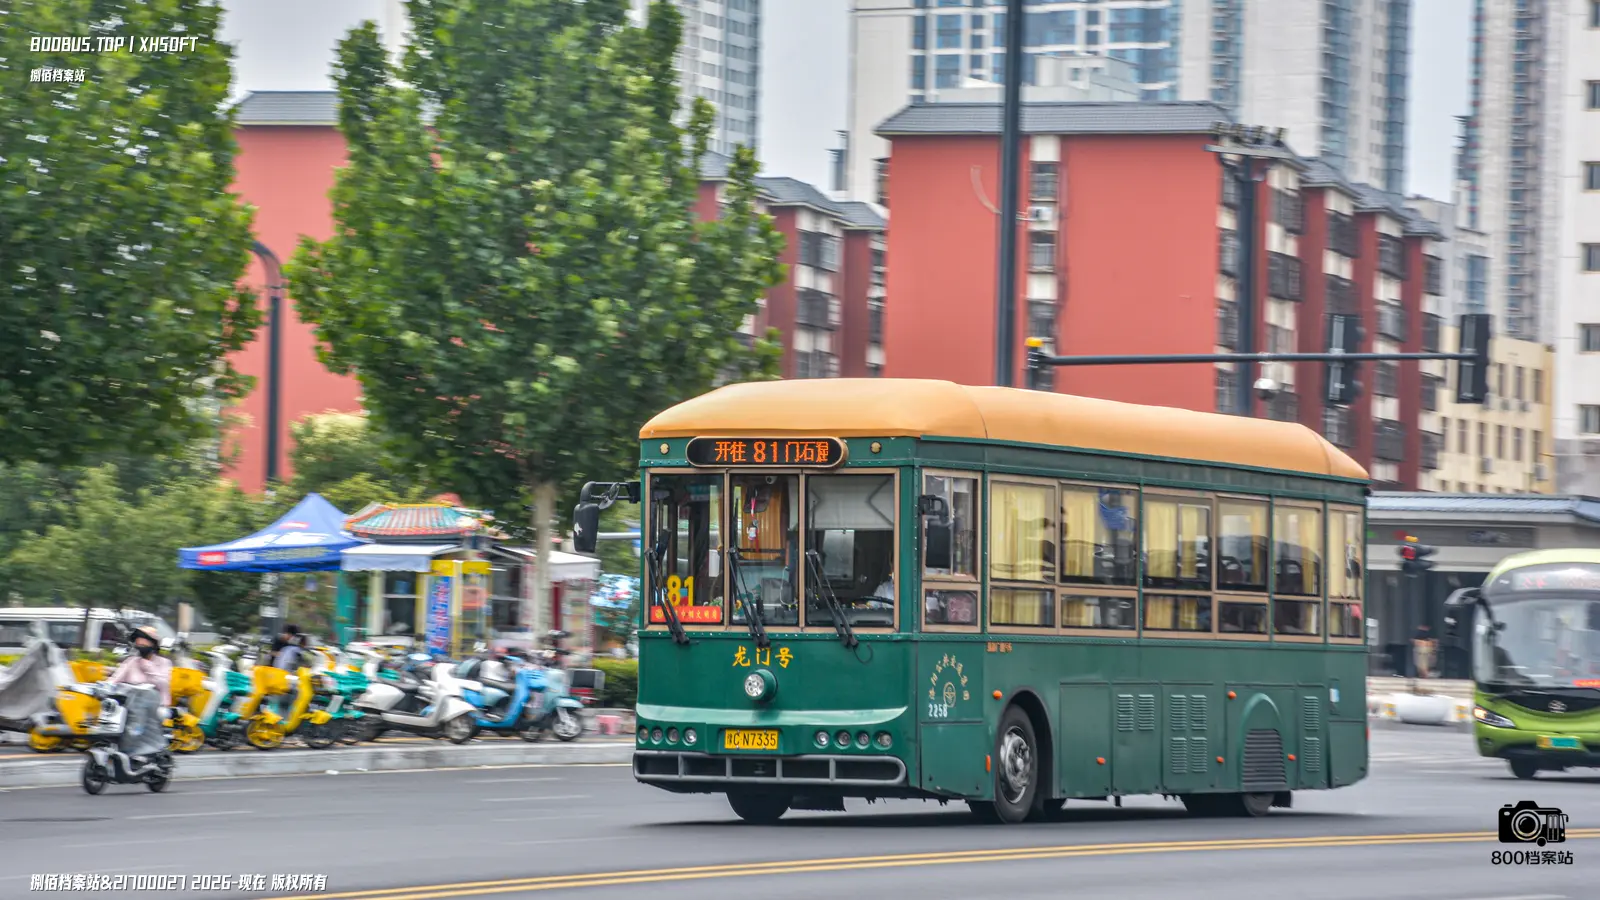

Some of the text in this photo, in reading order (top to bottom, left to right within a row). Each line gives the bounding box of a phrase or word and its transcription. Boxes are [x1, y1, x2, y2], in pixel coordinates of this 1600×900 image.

[715, 441, 746, 462] 开往
[753, 441, 778, 463] 81
[667, 574, 694, 607] 81
[732, 645, 794, 669] 龙门号
